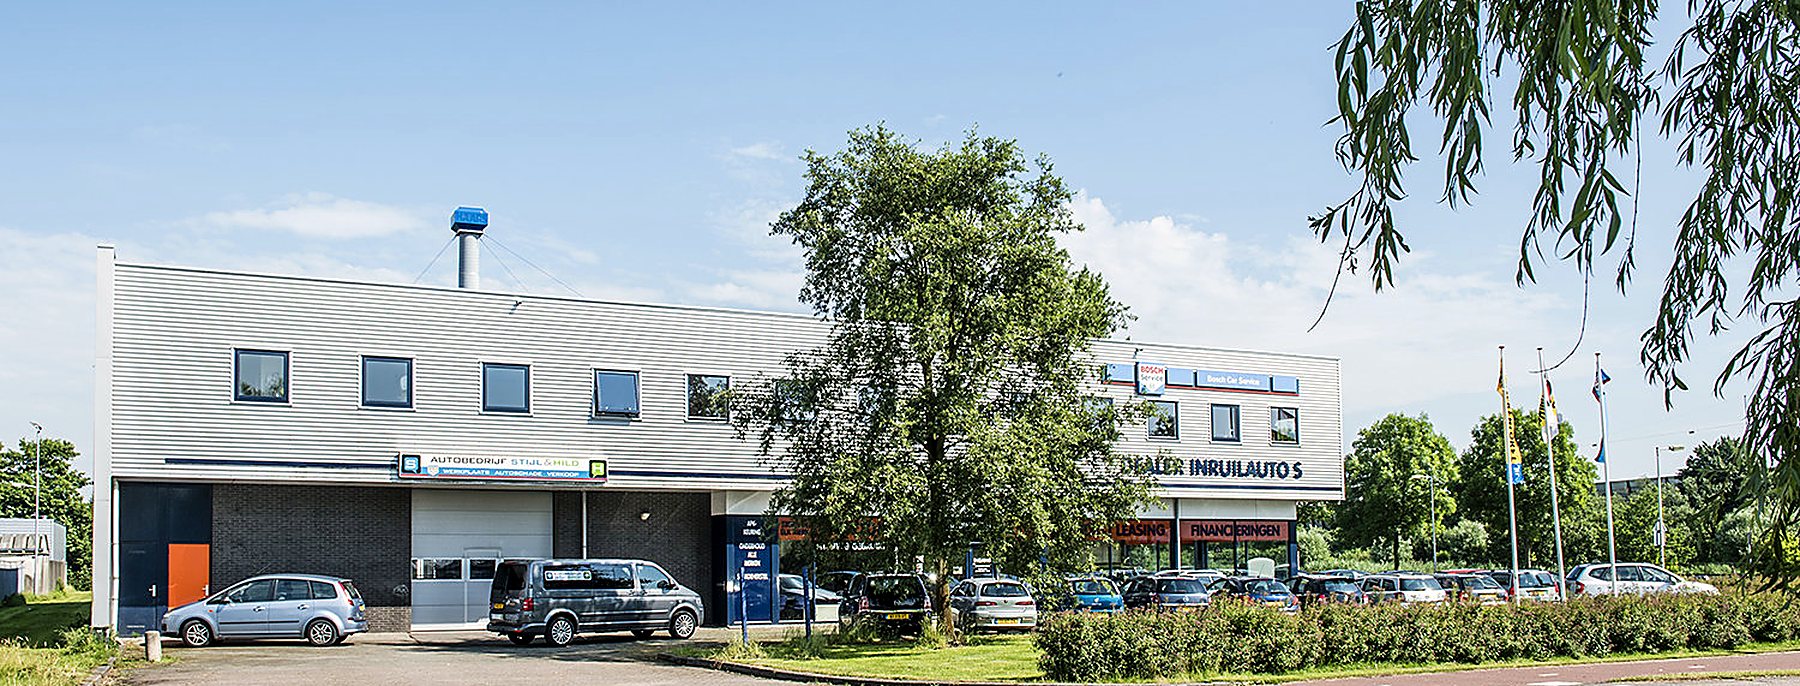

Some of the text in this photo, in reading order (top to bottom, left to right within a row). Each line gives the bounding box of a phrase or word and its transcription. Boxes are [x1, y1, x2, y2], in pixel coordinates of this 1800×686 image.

[1140, 366, 1163, 374] BOSCH
[1140, 373, 1163, 382] Service
[1207, 374, 1260, 386] Bosch Car Service
[431, 456, 506, 465] AUTOBEDRIJF
[443, 468, 490, 476] WERKPLAATS
[1189, 458, 1289, 479] INRUILAUTO
[1293, 461, 1303, 479] S
[1116, 523, 1165, 537] LEASING
[1190, 525, 1281, 537] FINANCIERINGEN
